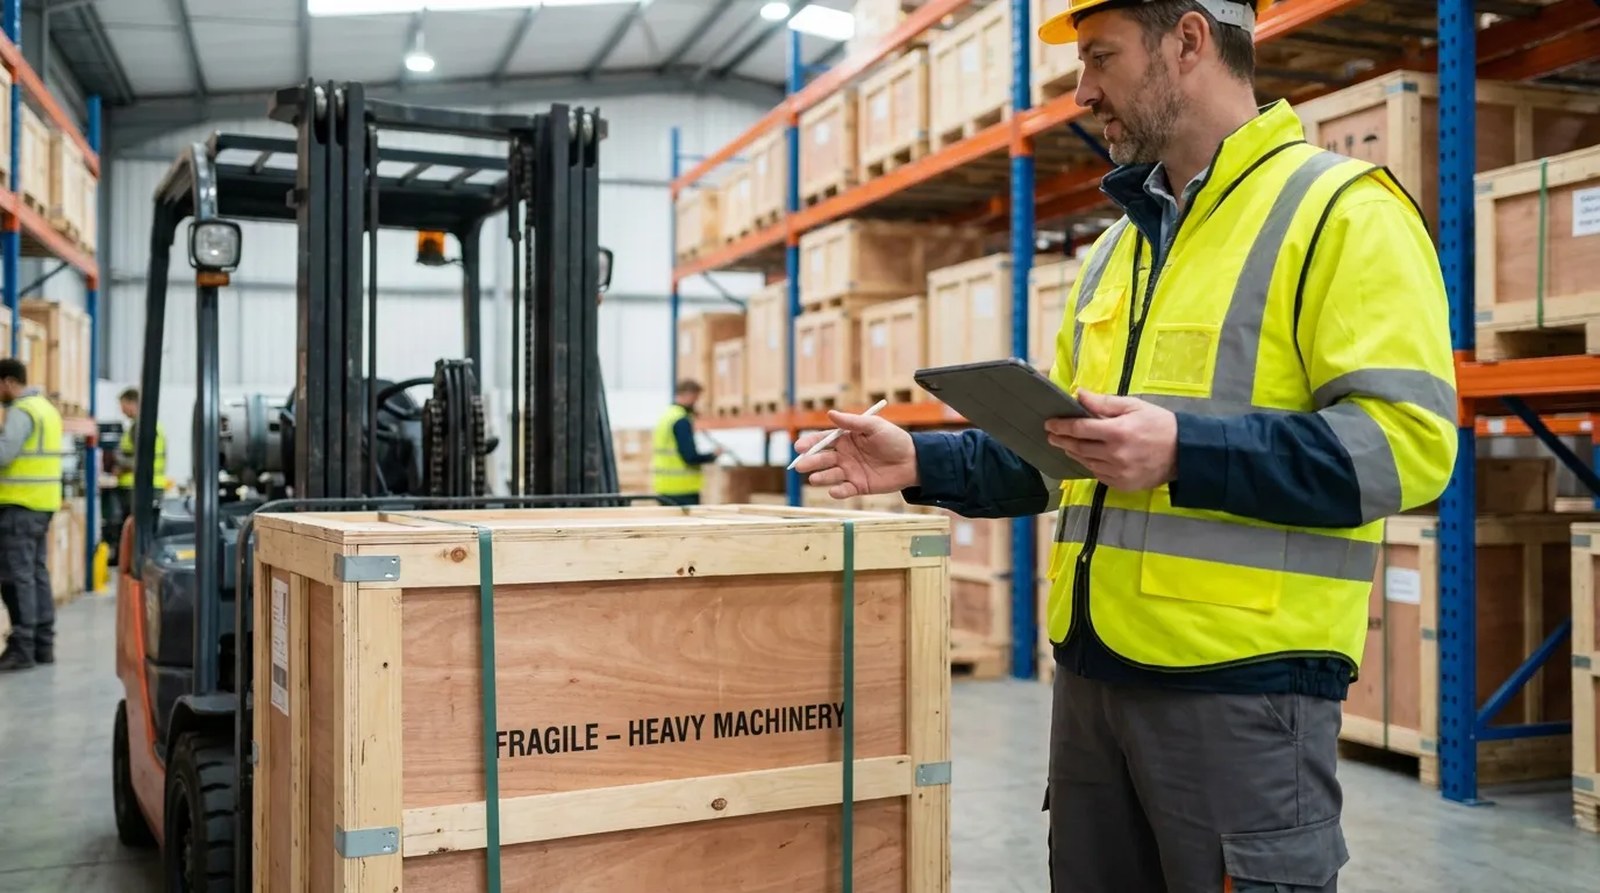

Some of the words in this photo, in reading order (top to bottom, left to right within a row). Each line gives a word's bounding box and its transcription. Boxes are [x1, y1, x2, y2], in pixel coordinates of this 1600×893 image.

[496, 723, 599, 758] FRAGILE
[629, 714, 706, 746] HEAVY
[714, 702, 845, 739] MACHINERY
